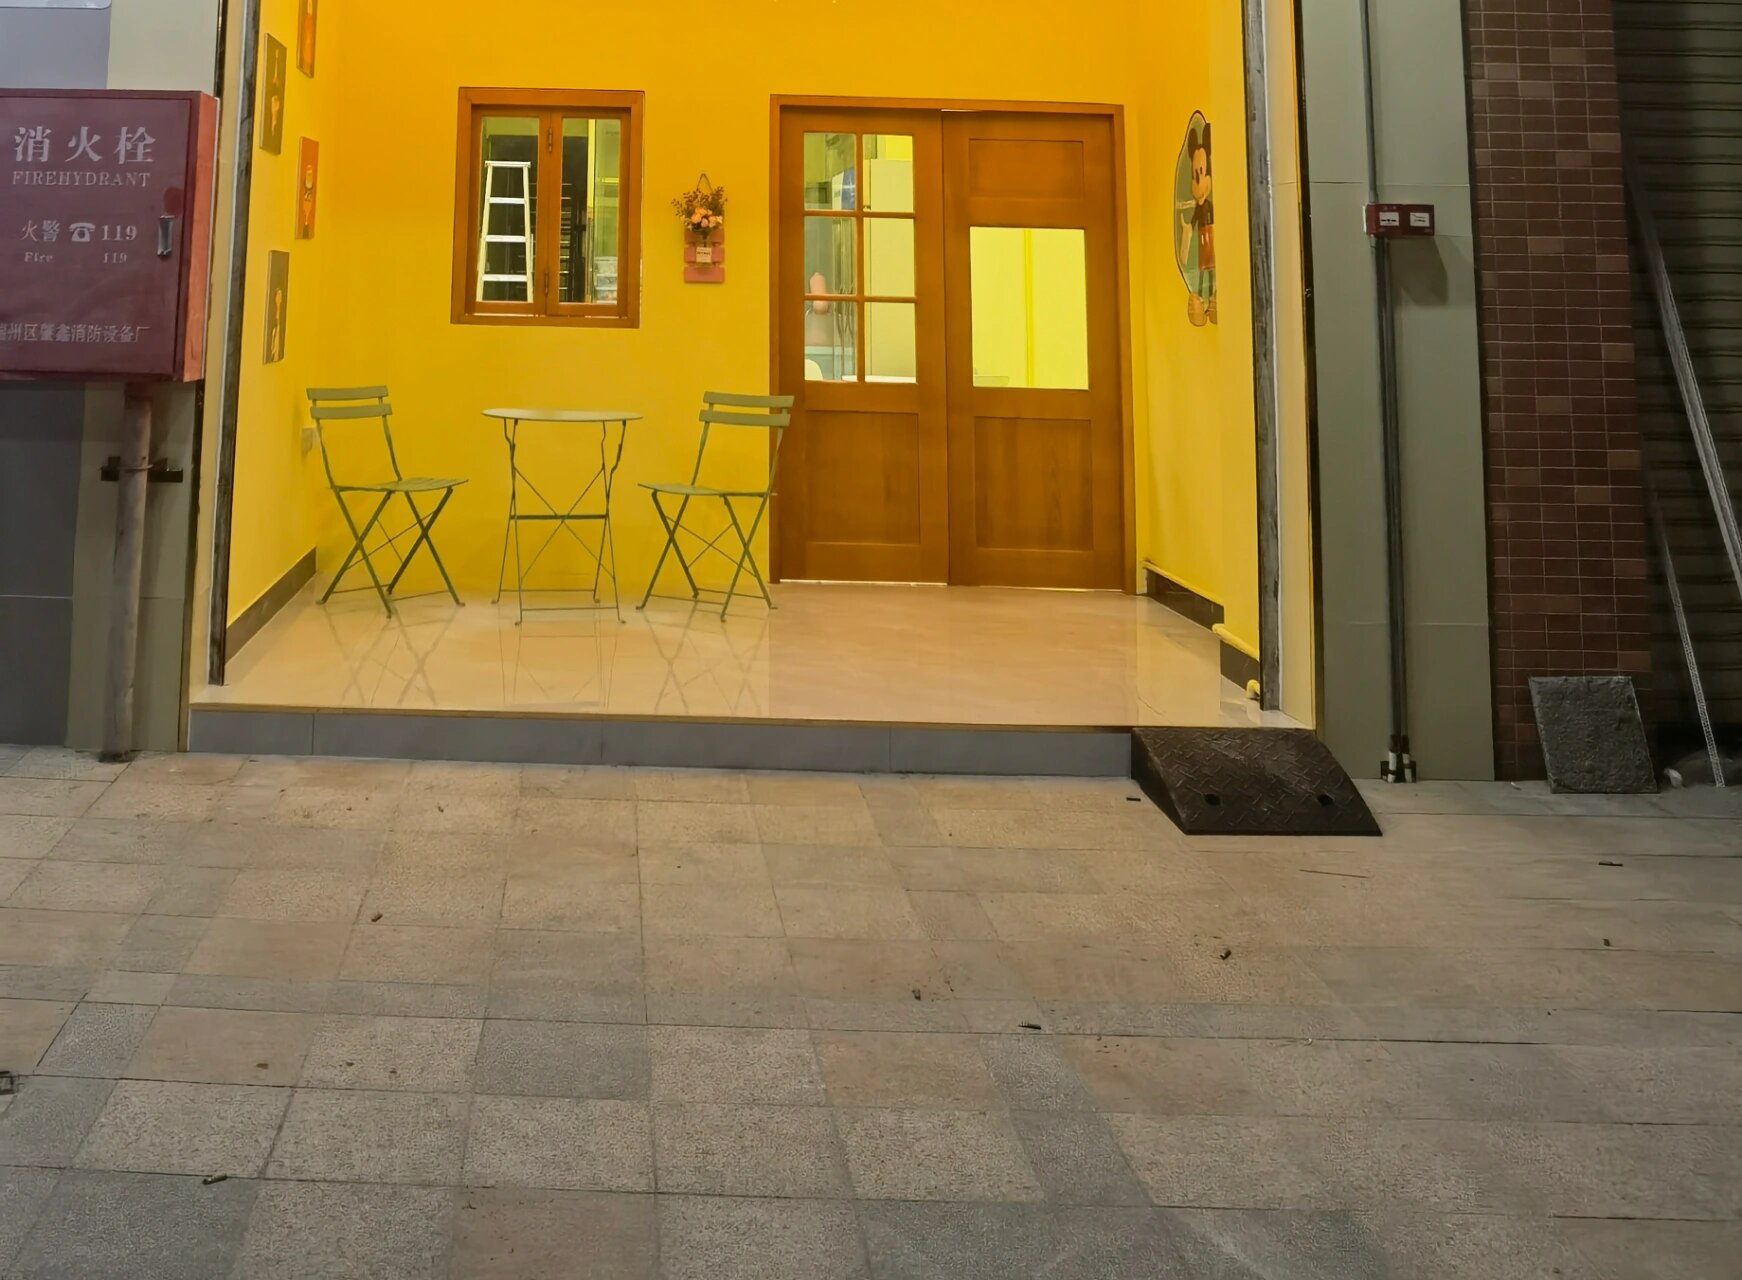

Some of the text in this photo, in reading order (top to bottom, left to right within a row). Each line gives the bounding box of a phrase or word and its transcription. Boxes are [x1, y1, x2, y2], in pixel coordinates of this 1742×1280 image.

[14, 126, 156, 164] 消火栓
[12, 171, 150, 186] FIREHYDRANT
[20, 220, 137, 243] 火警 119
[24, 252, 128, 263] Fire 119
